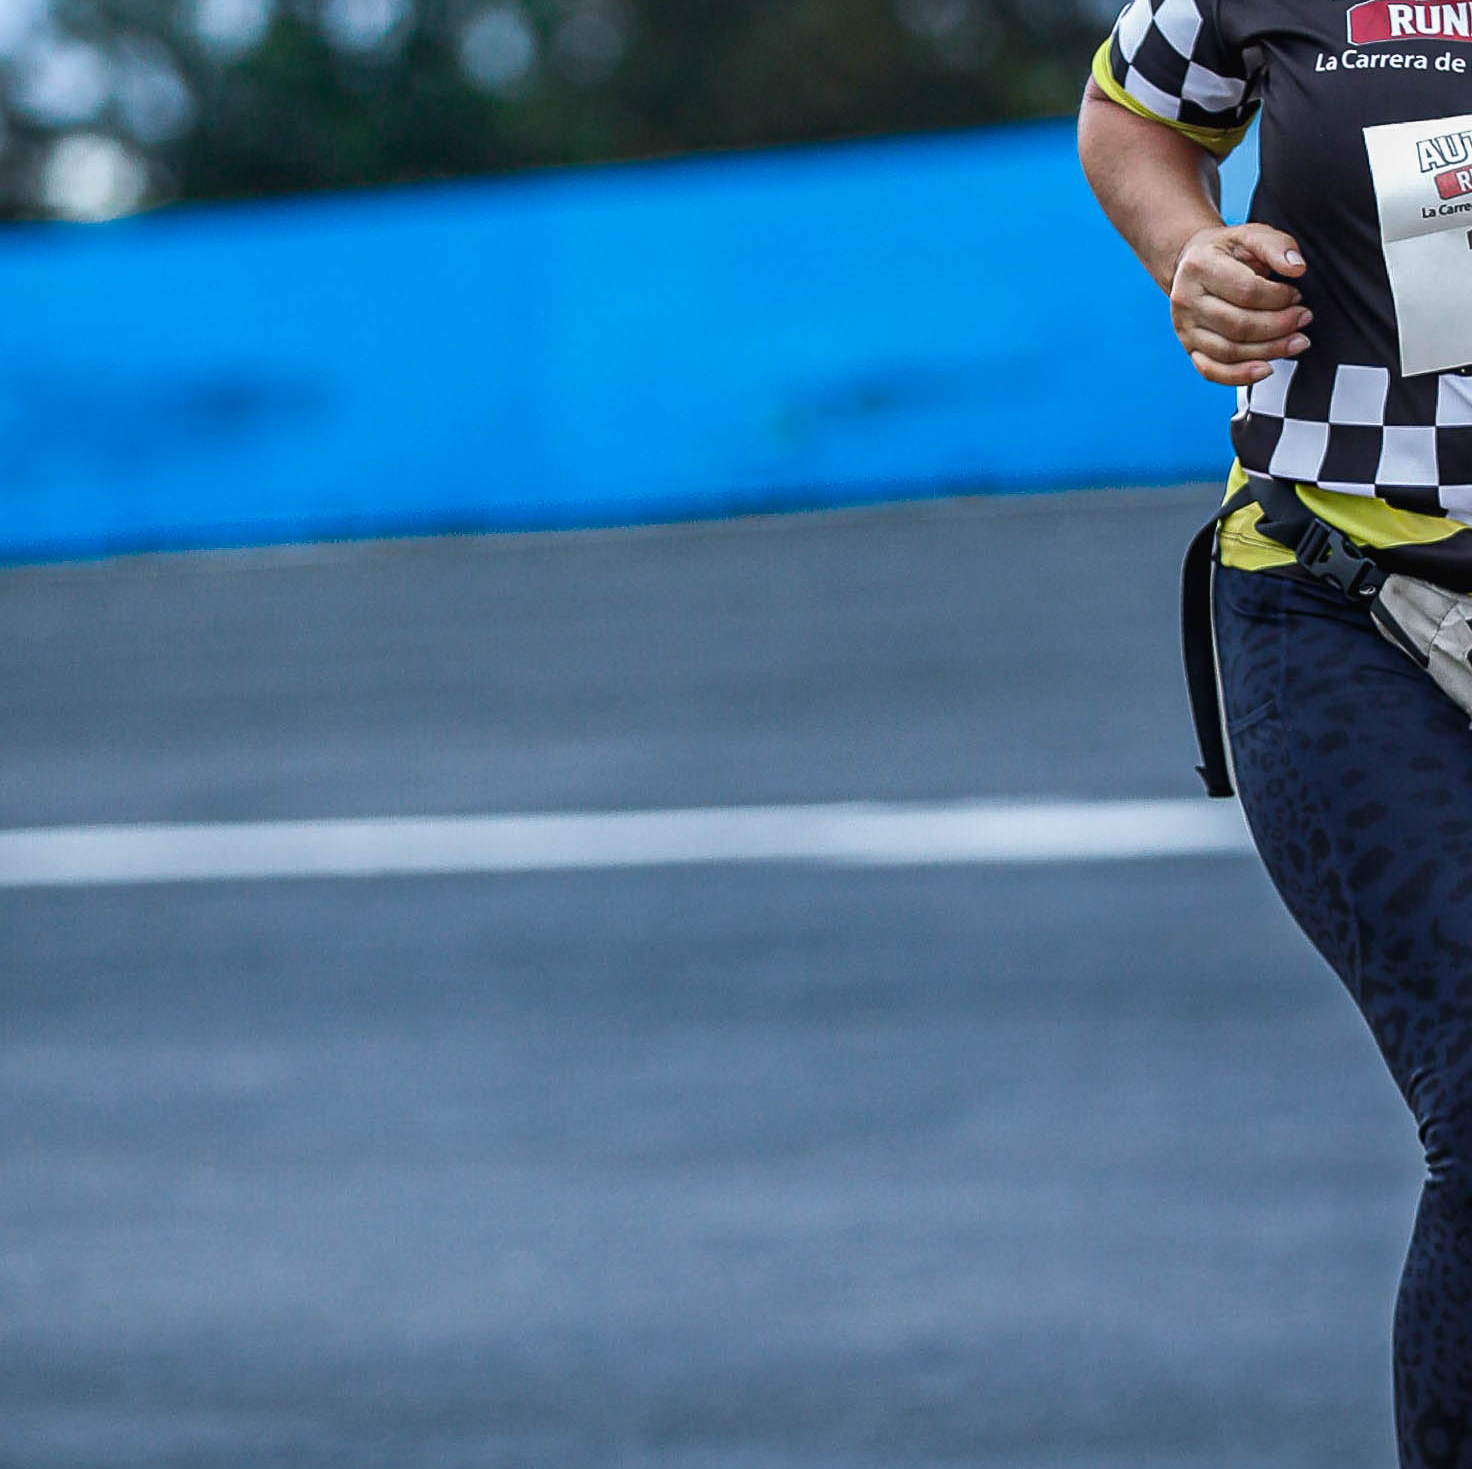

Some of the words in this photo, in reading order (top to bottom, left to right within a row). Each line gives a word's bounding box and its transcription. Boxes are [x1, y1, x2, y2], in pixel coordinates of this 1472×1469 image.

[1315, 54, 1338, 72] La
[1341, 50, 1427, 70] Carrera
[1435, 53, 1466, 72] de
[1422, 207, 1436, 218] La
